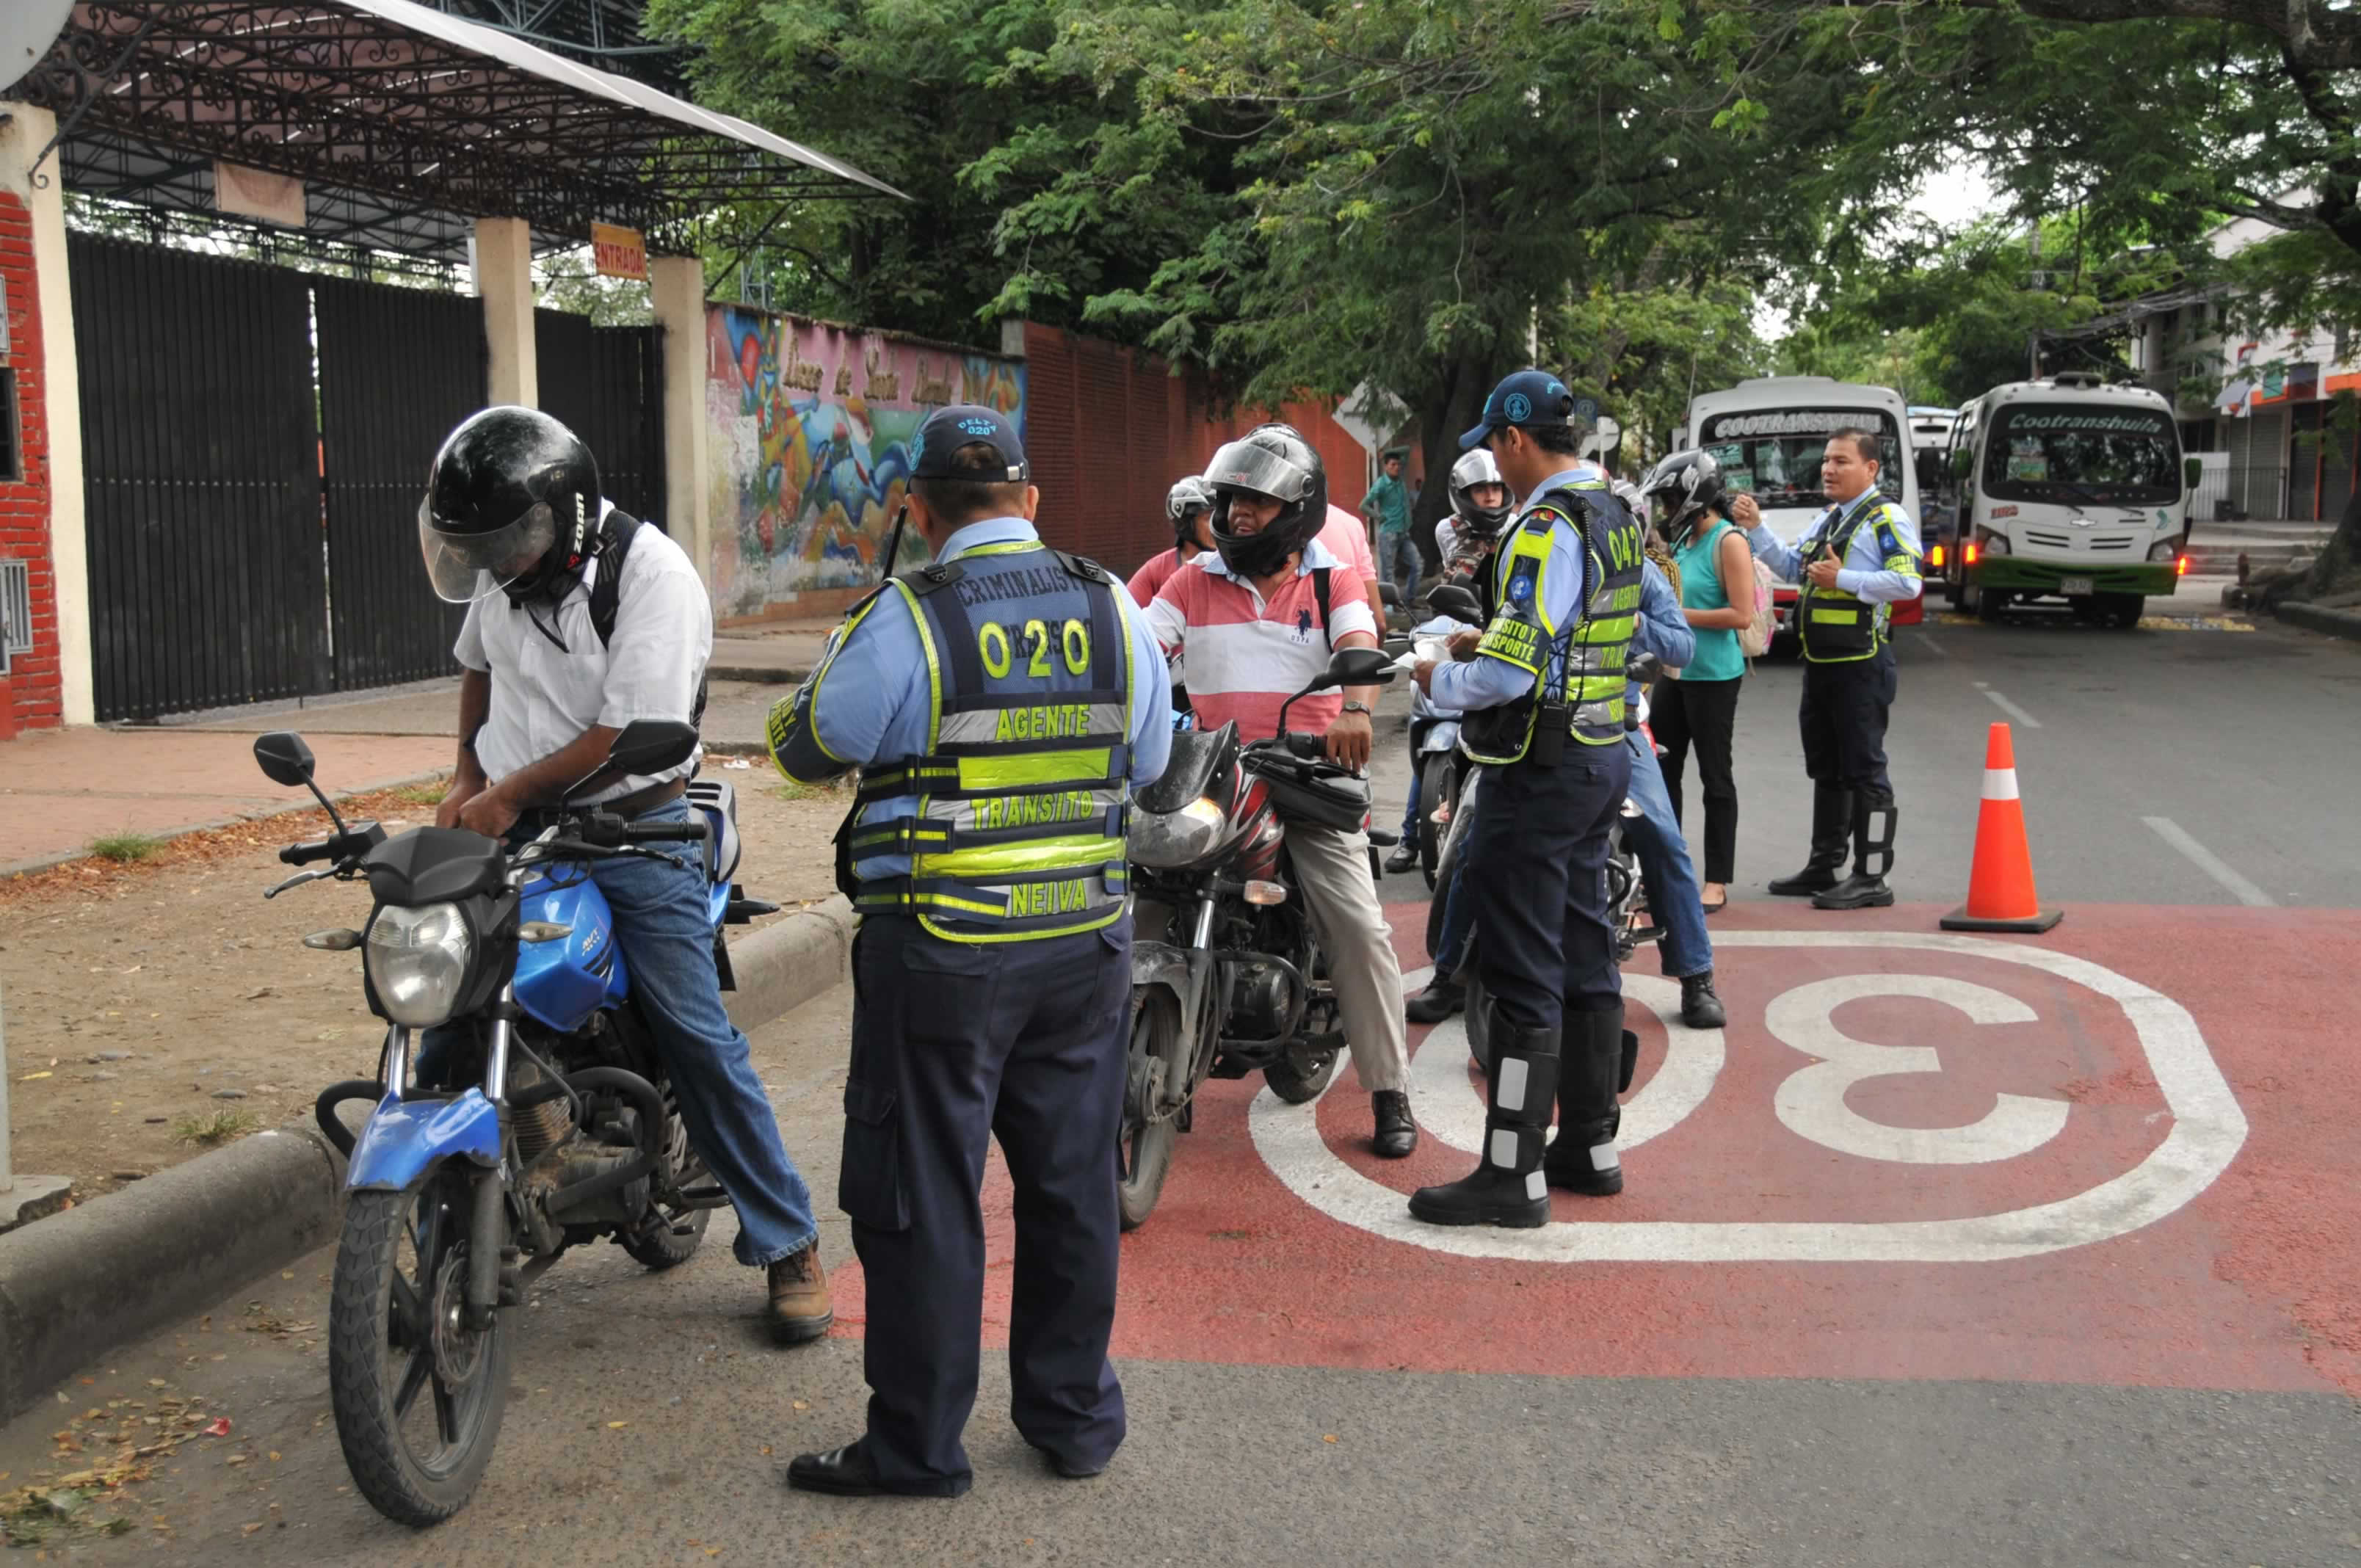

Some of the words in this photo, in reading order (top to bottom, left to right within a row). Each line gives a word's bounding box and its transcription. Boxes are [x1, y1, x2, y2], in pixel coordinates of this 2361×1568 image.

[595, 242, 644, 275] ENTRADA
[968, 426, 990, 435] 020
[1608, 524, 1642, 571] 042
[979, 618, 1090, 680] 020
[1528, 627, 1539, 644] Y
[995, 703, 1090, 741] AGENTE
[970, 790, 1094, 831] TRANSITO
[1010, 879, 1087, 917] NEIVA
